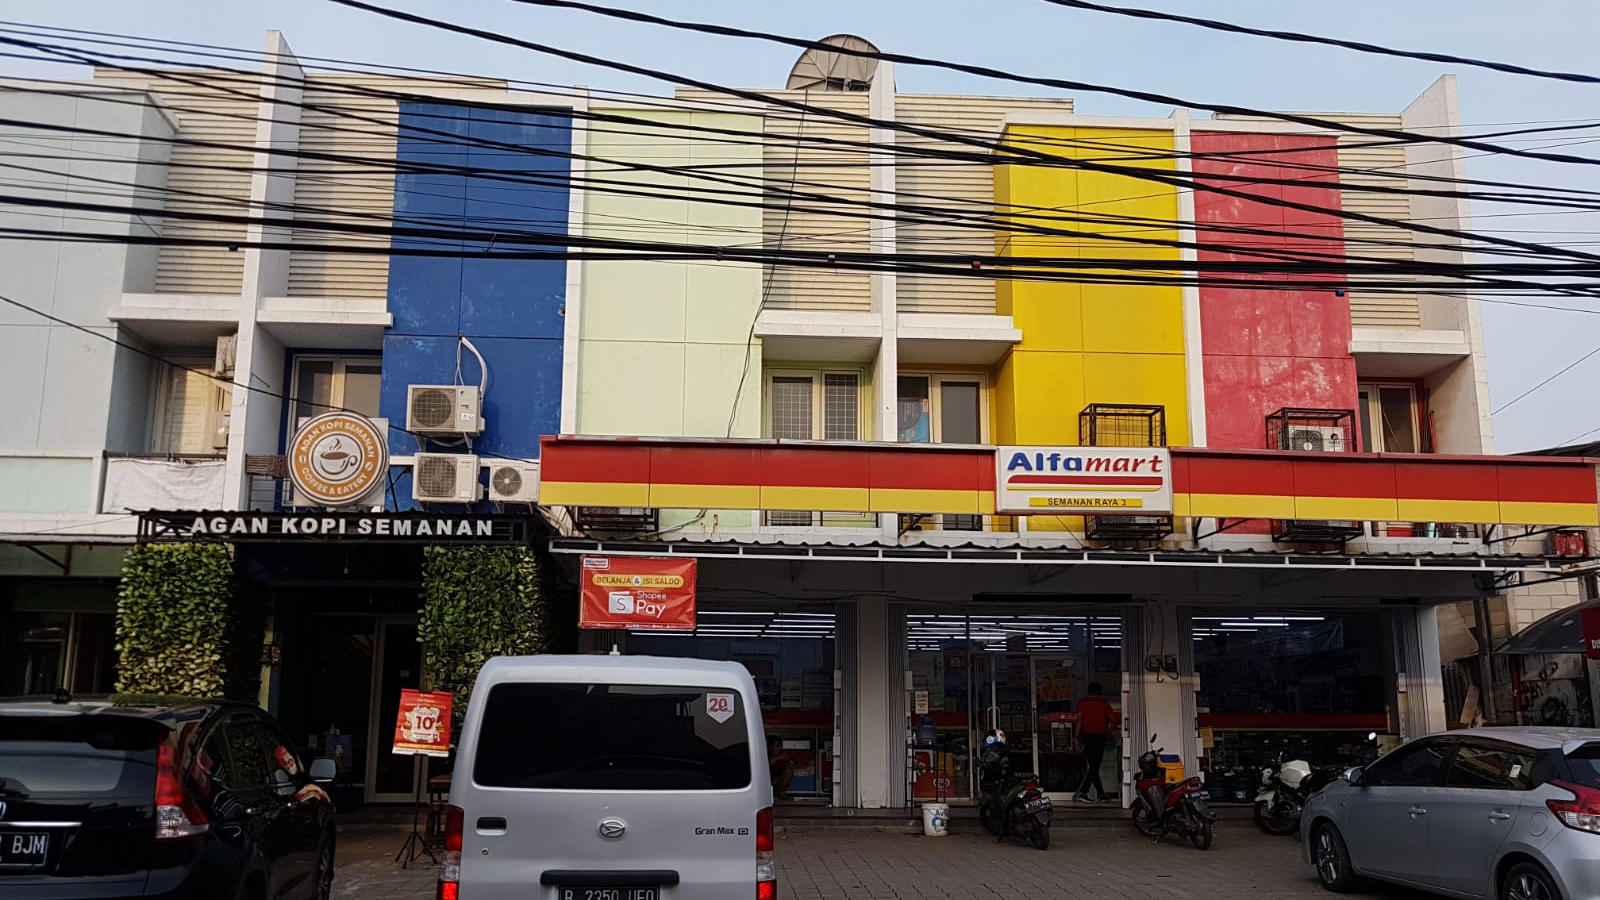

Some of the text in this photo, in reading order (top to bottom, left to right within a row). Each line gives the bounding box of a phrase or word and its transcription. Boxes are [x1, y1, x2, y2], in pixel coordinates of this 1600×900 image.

[301, 421, 375, 458] AGAN KOPI SEMANAN
[1007, 452, 1163, 472] Alfamart
[302, 468, 328, 493] COFFEE
[337, 473, 368, 494] EATERY
[1048, 497, 1127, 507] SEMANAN RAYA 3
[191, 517, 493, 536] AGAN KOPI SEMANAN
[596, 576, 631, 584] BELANJA
[637, 590, 667, 600] Shopee
[636, 600, 666, 619] Pay
[695, 827, 716, 835] Gran
[717, 826, 735, 835] Max
[11, 835, 46, 854] BJM
